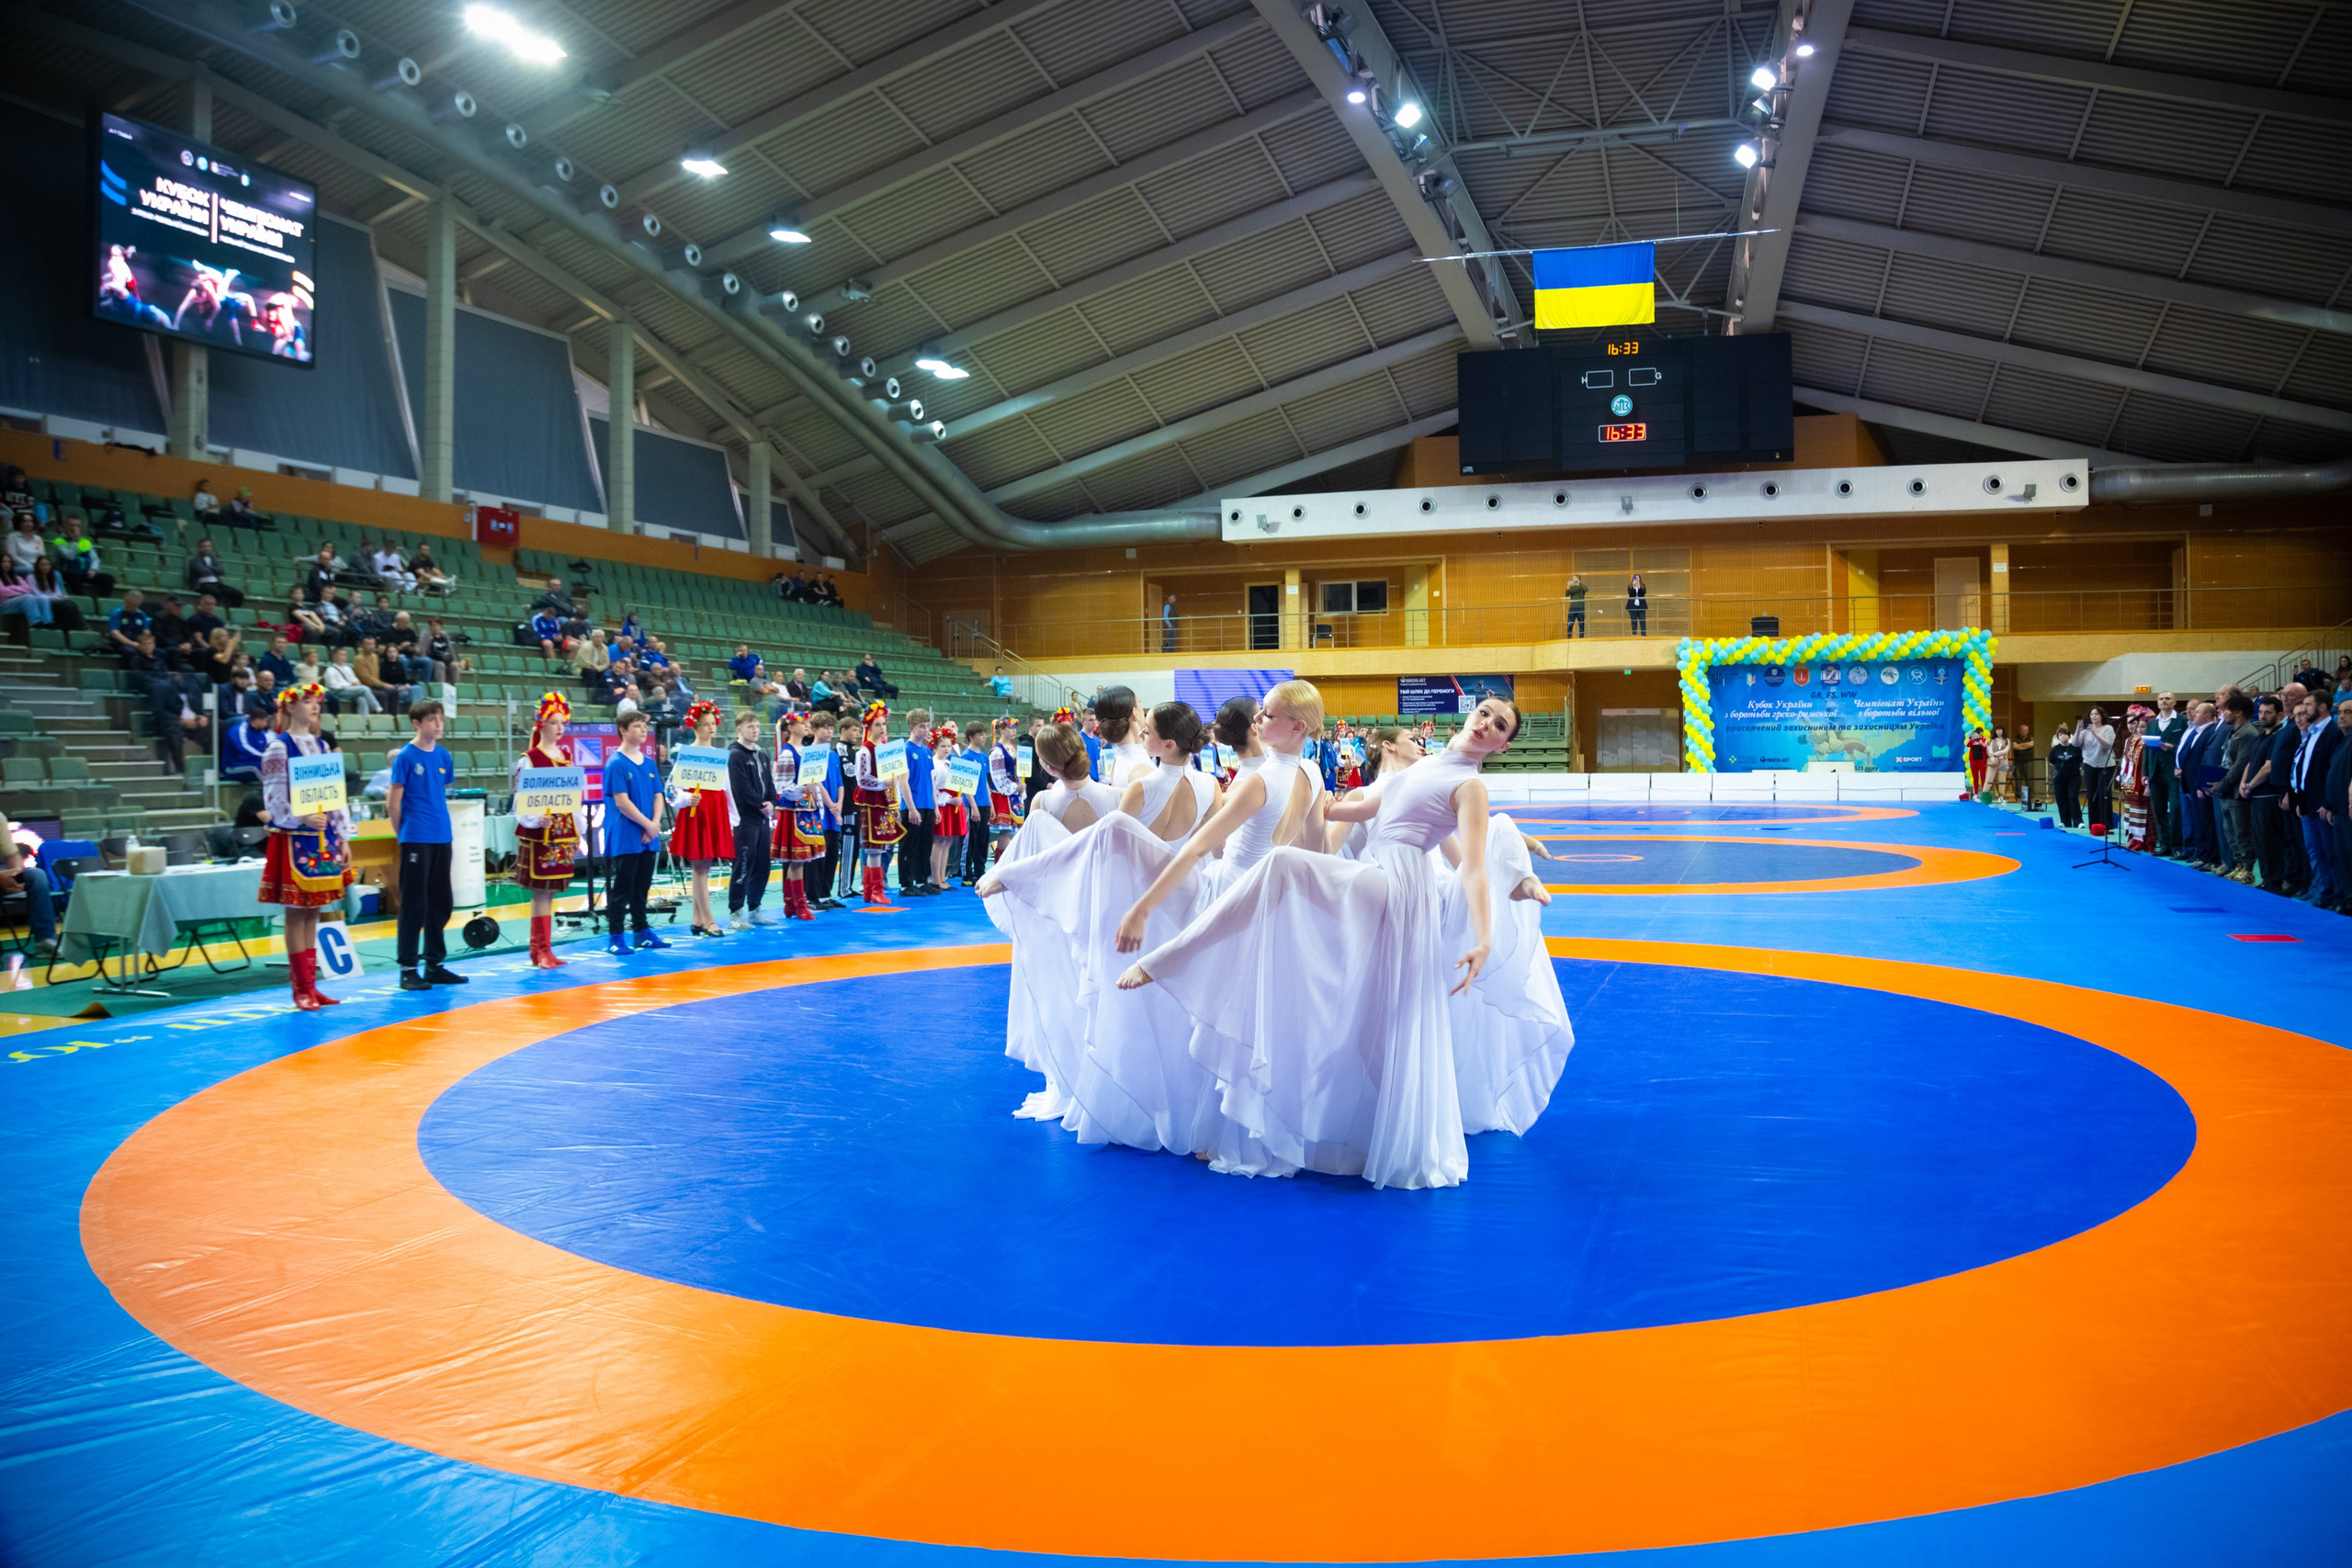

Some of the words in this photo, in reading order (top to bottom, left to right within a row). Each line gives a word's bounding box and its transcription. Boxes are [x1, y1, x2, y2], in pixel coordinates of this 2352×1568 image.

[155, 175, 210, 208] КУБОК
[139, 188, 209, 226] УКРАЇНИ
[219, 214, 283, 248] УКРАЇНИ
[1608, 342, 1639, 355] 16:33
[1581, 376, 1588, 384] H
[1655, 371, 1662, 379] G
[1606, 423, 1645, 441] 16:33
[1747, 700, 1773, 713] Кубок
[1776, 700, 1813, 713] України
[1853, 699, 1905, 708] Чемпіонат
[1906, 698, 1944, 709] України
[1729, 710, 1770, 721] боротьби
[1772, 710, 1838, 721] греко-римської
[1863, 708, 1905, 719] боротьби
[1908, 708, 1941, 716] вільної
[598, 724, 613, 732] 405
[1725, 724, 1781, 733] присвячений
[1853, 724, 1907, 732] захисницям
[1909, 723, 1945, 732] України
[679, 754, 726, 764] ДНІПРОПЕТРОВСЬКА
[803, 750, 827, 762] ДОНЕЦЬКА
[877, 746, 903, 759] ЖИТОМИРСЬКА
[294, 762, 340, 781] ВІННИЦЬКА
[802, 765, 823, 777] ОБЛАСТЬ
[882, 760, 903, 773] ОБЛАСТЬ
[950, 762, 978, 775] ЗАКАРПАТСЬКА
[523, 776, 579, 789] ВОЛИНСЬКА
[681, 769, 718, 783] ОБЛАСТЬ
[951, 775, 973, 788] ОБЛАСТЬ
[300, 785, 338, 804] ОБЛАСТЬ
[527, 795, 572, 807] ОБЛАСТЬ
[318, 926, 354, 976] C
